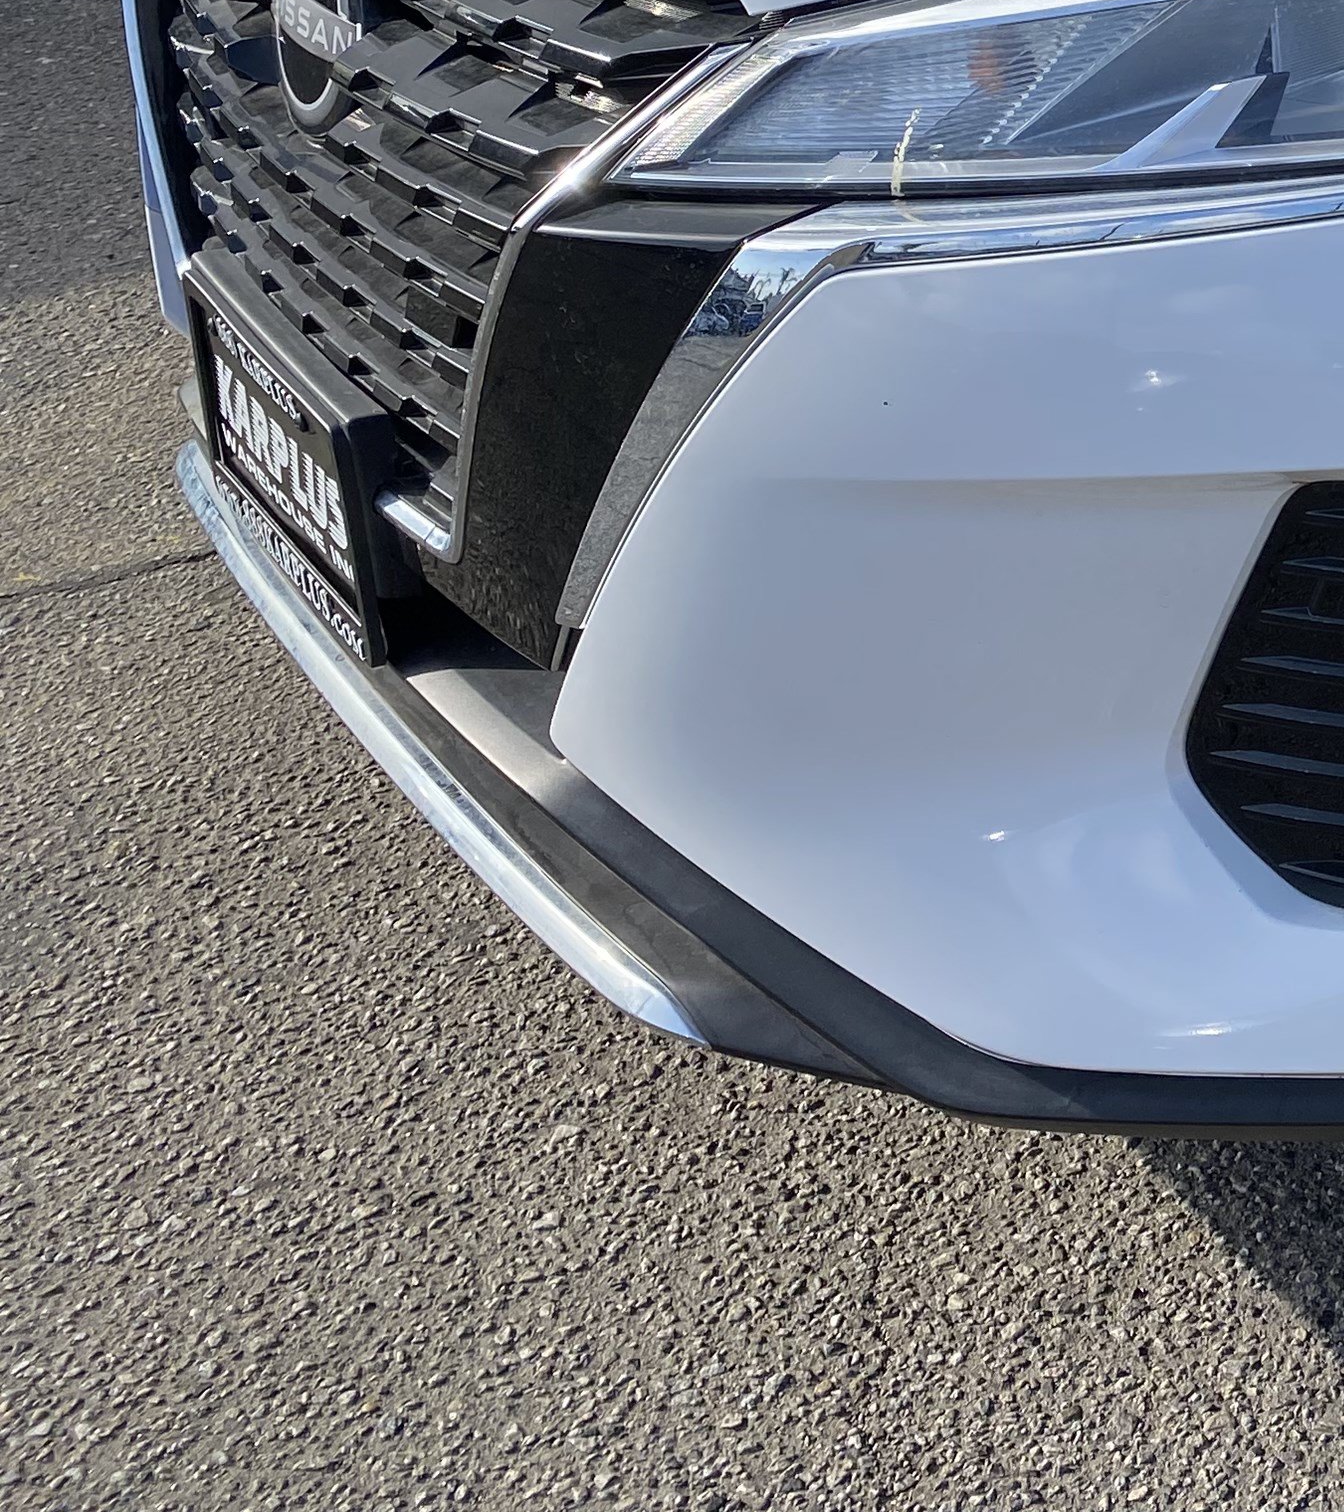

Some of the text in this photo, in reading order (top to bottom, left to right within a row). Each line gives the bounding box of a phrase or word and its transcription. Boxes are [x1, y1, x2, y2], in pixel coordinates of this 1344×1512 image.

[214, 354, 348, 550] KARPLUS
[221, 423, 355, 582] WAREHOUSE IN
